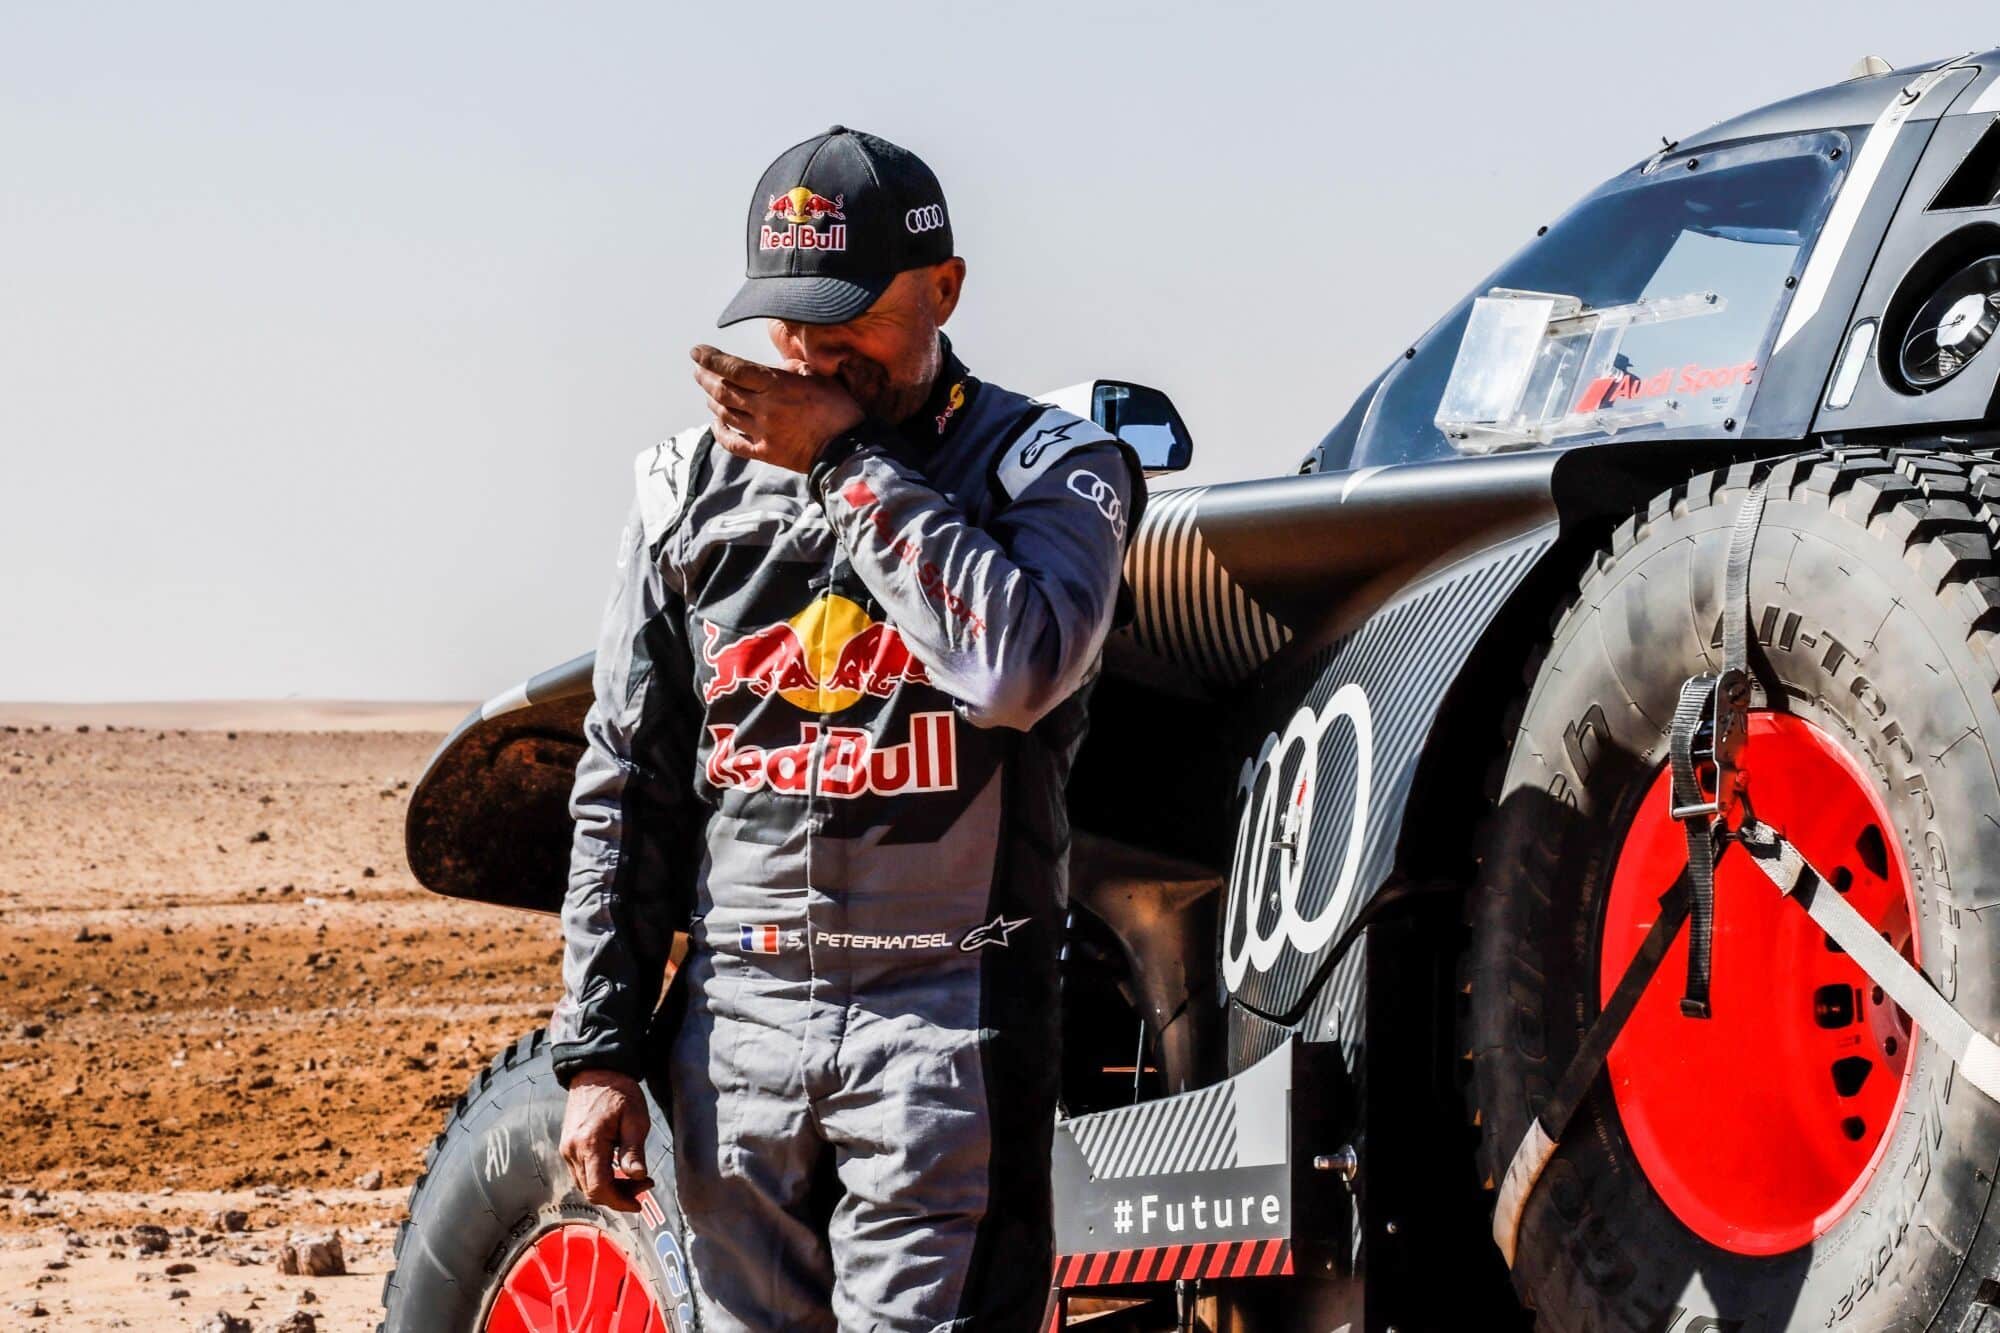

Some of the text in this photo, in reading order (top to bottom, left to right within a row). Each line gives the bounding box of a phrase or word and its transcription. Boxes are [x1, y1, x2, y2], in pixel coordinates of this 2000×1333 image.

[760, 224, 846, 250] Red Bull
[1610, 367, 1674, 403] Audi
[1675, 360, 1757, 396] Sport
[706, 711, 958, 800] Red Bull
[815, 932, 953, 950] PETERHANSEL
[1113, 1194, 1281, 1235] #Future
